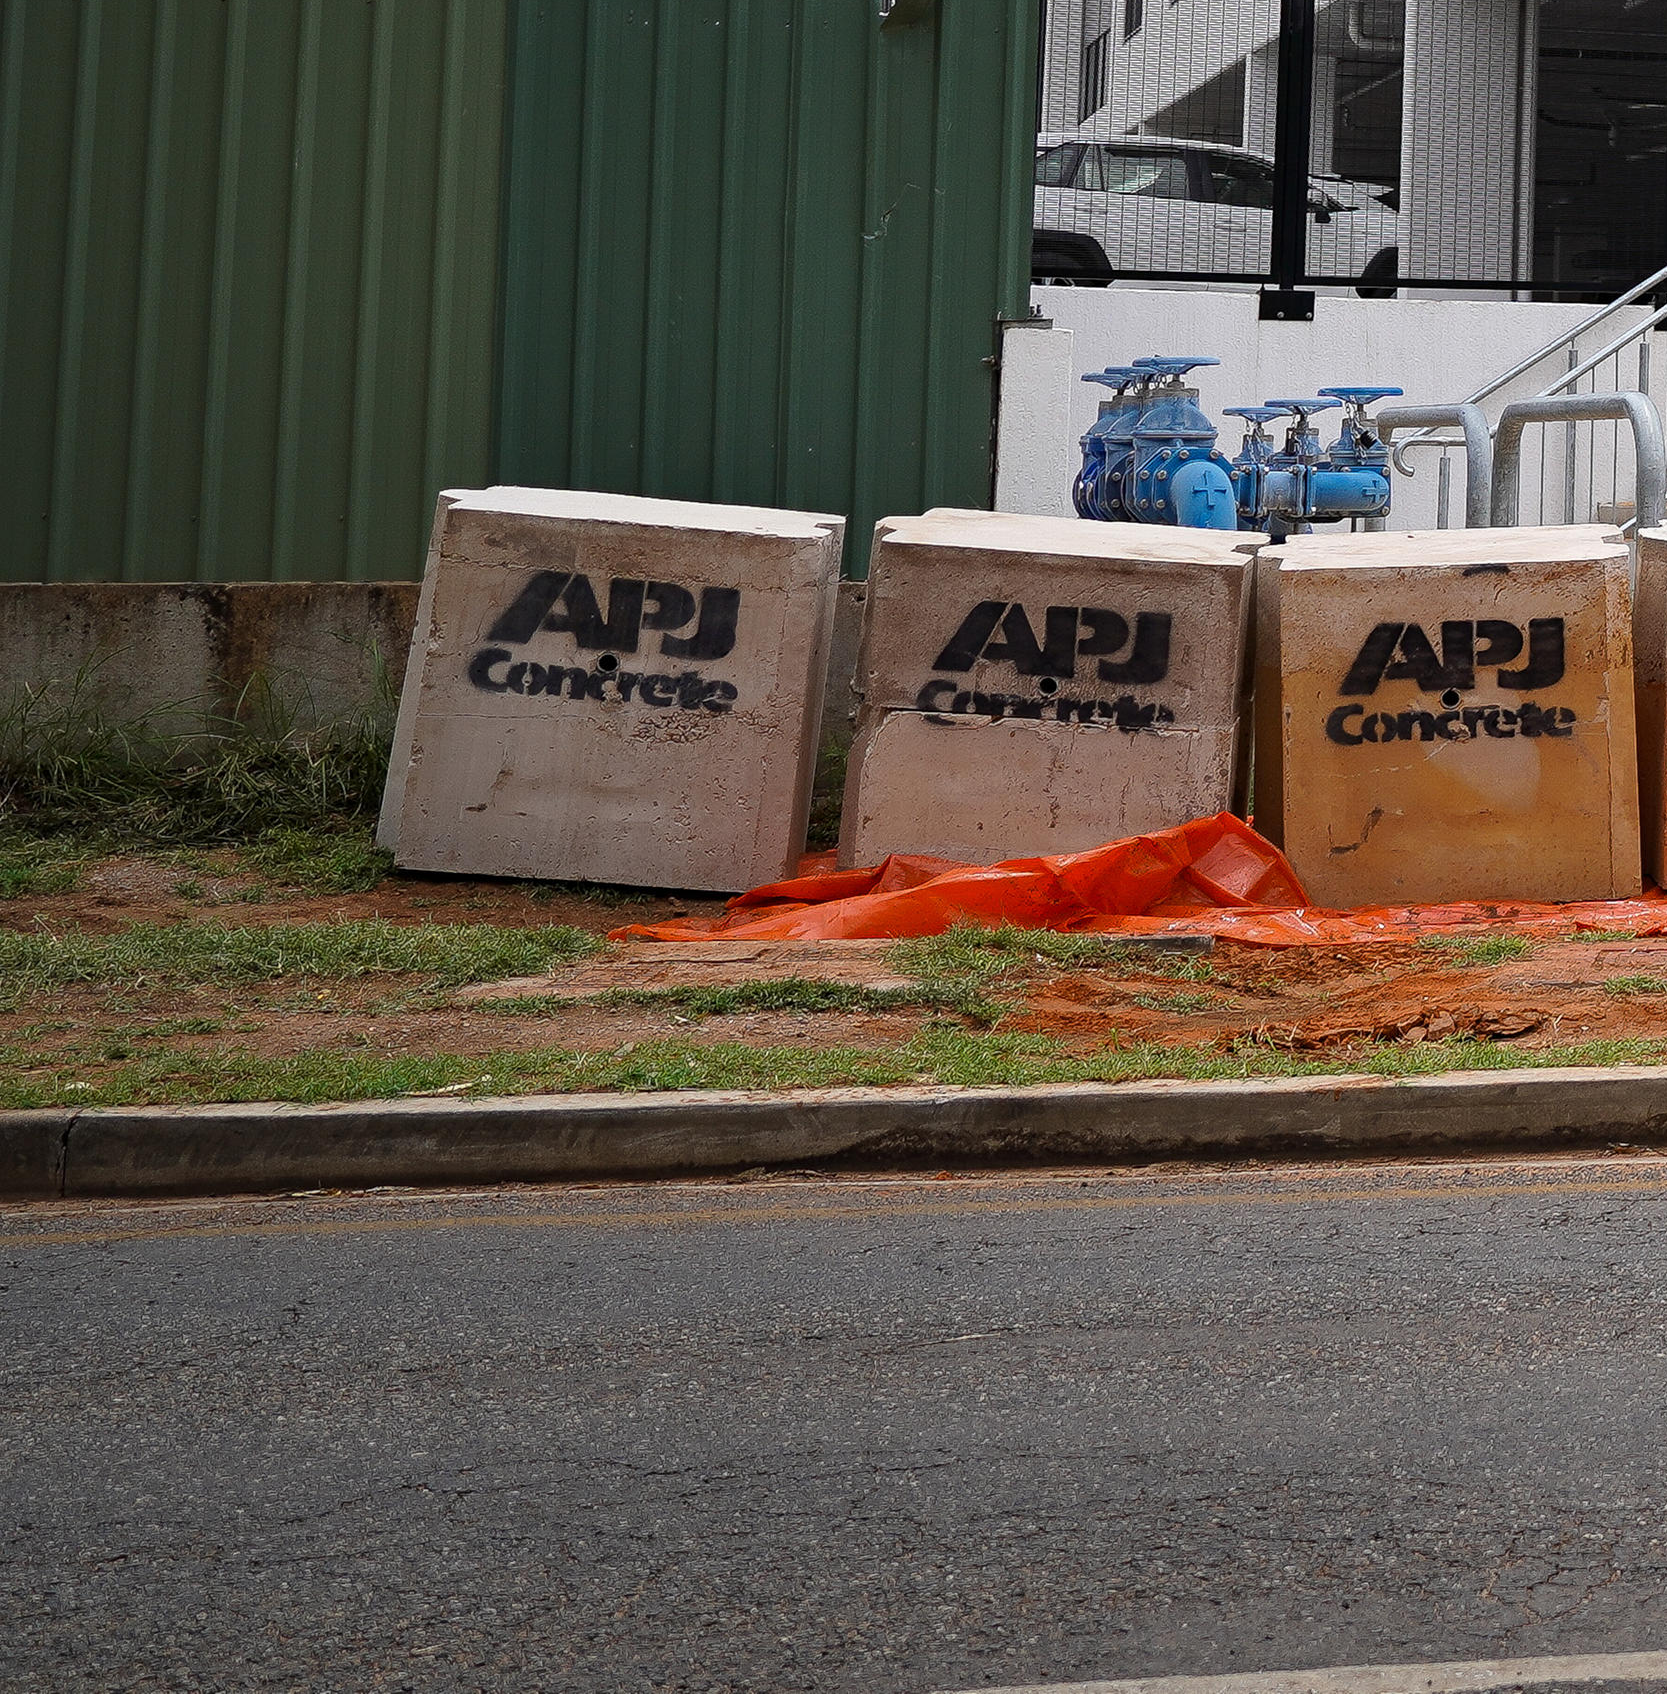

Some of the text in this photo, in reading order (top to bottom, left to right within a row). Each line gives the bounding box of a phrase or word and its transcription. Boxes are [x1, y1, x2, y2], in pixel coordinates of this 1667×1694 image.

[487, 570, 740, 661] APJ
[931, 600, 1172, 685] APJ
[468, 647, 738, 711] Concrete
[1338, 617, 1565, 696] APJ
[1325, 701, 1576, 746] Concrete
